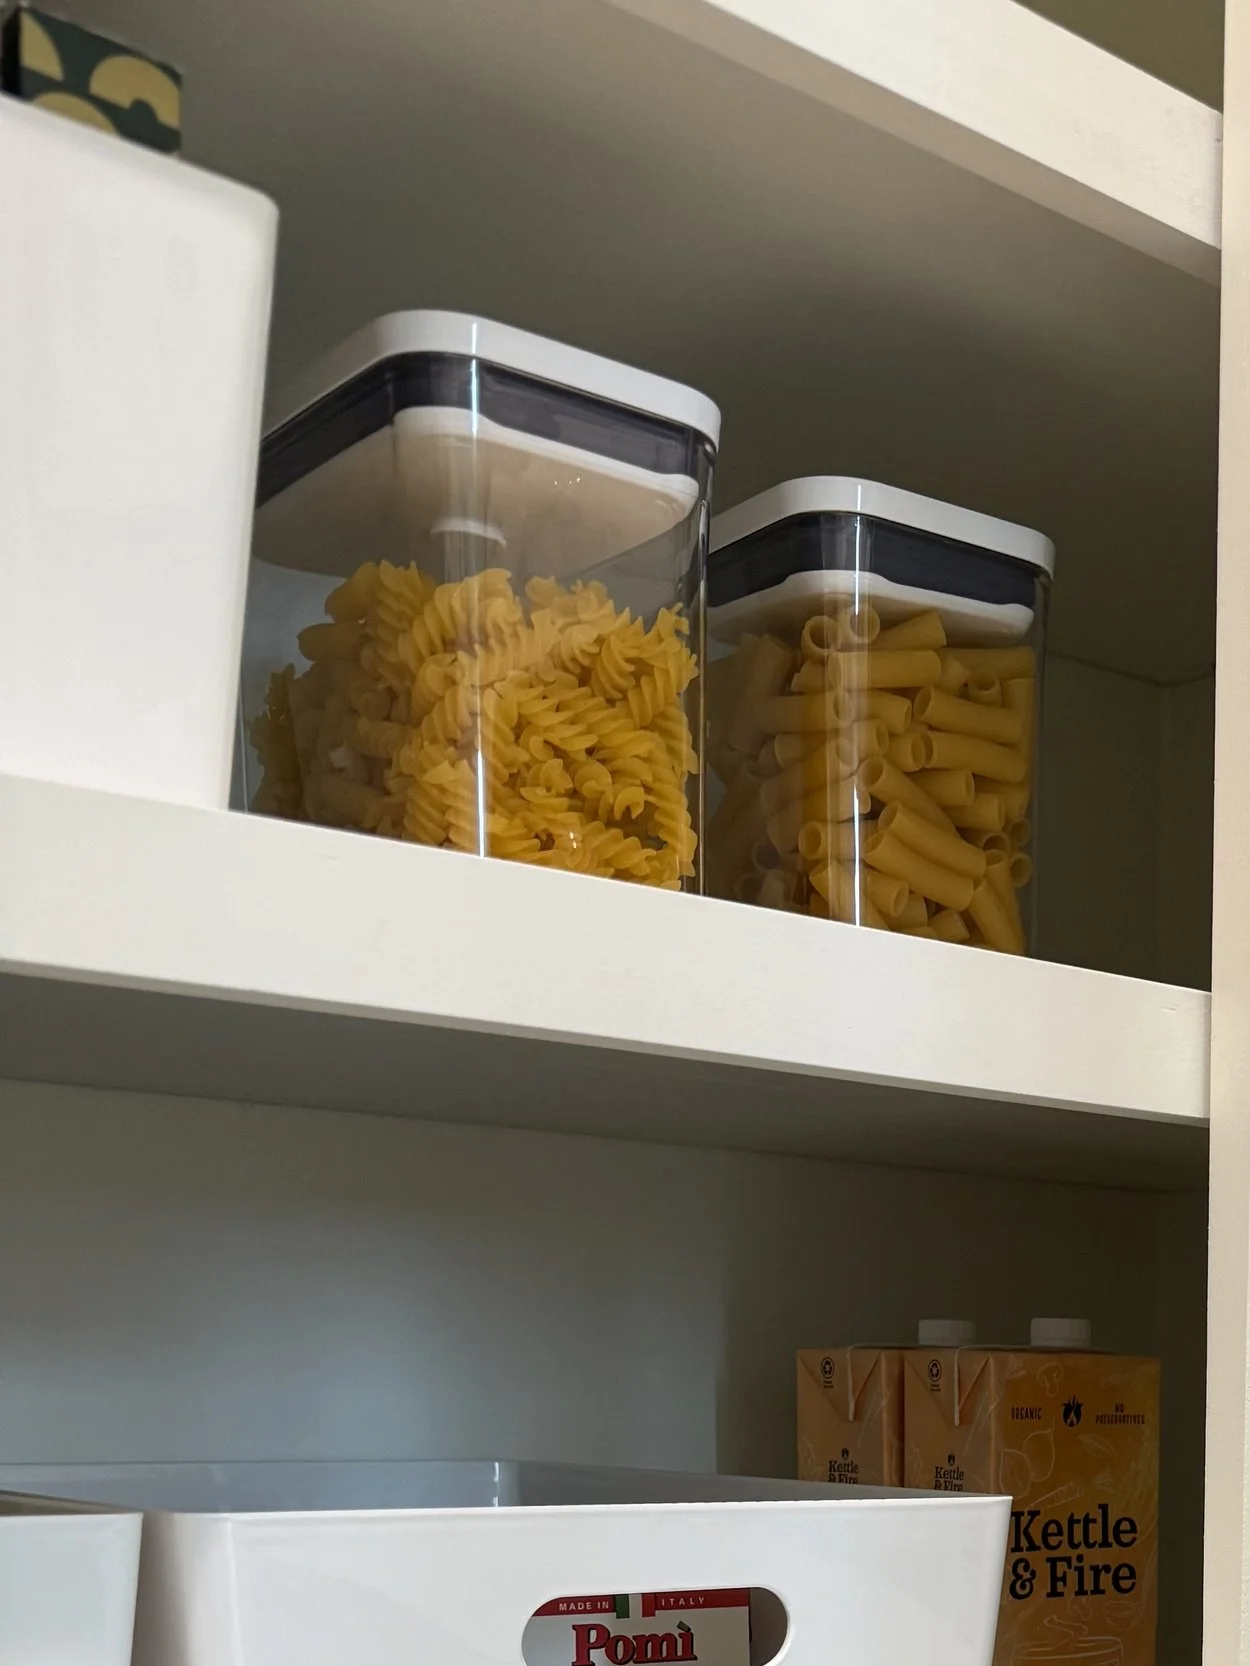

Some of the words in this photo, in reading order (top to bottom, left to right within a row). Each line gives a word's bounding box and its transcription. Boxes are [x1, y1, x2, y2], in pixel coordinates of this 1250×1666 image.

[1011, 1406, 1042, 1420] ORGANIC
[829, 1460, 859, 1474] Kettle
[935, 1466, 965, 1481] Kettle
[838, 1474, 858, 1484] Fire
[944, 1480, 963, 1491] Fire
[1010, 1503, 1138, 1553] Kettle
[1009, 1558, 1037, 1600] &
[1046, 1554, 1137, 1598] Fire
[558, 1601, 593, 1612] MADE
[597, 1600, 610, 1610] IN
[661, 1596, 706, 1607] ITALY
